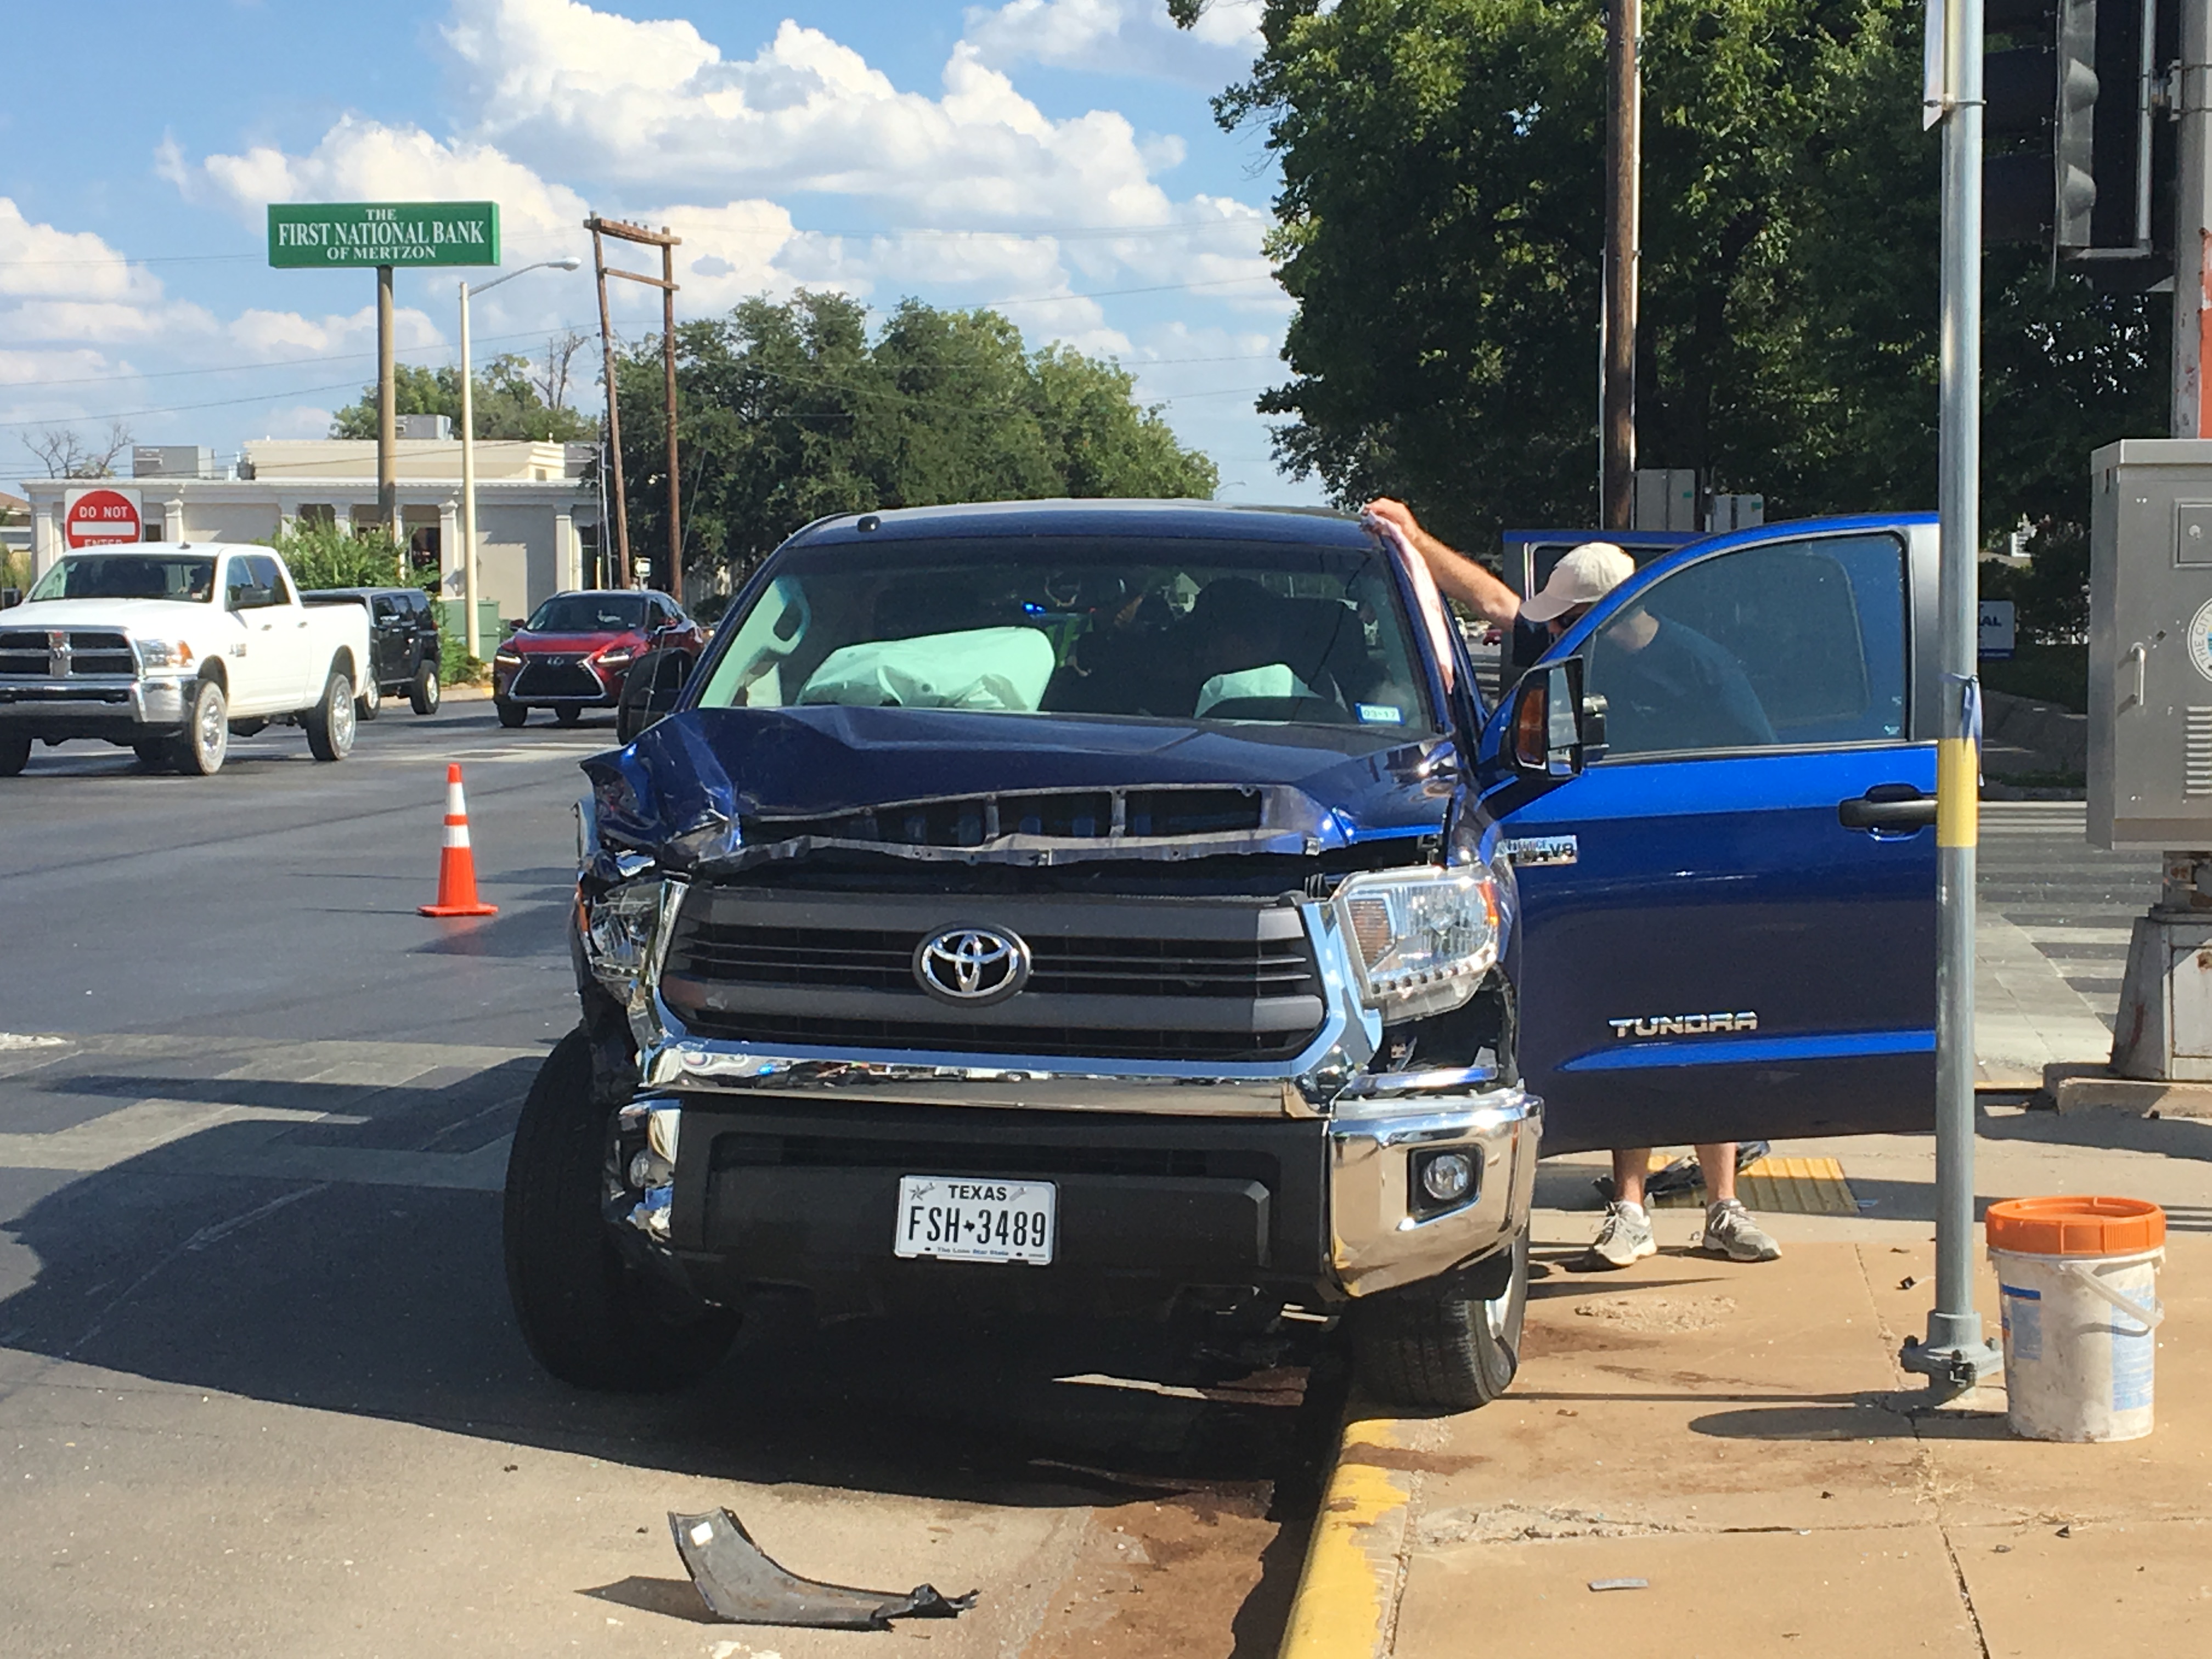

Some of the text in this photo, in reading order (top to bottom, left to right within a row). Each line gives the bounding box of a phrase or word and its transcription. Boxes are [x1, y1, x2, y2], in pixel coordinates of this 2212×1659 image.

[365, 208, 397, 221] THE
[278, 221, 485, 246] FIRST NATIONAL BANK
[327, 245, 437, 260] OF MERTZON
[79, 506, 128, 518] DO NOT
[2194, 640, 2209, 664] THE
[1548, 842, 1575, 857] V8
[1608, 1011, 1757, 1037] TUNDRA
[948, 1185, 1007, 1201] TEXAS
[908, 1206, 1046, 1247] FSH 3489
